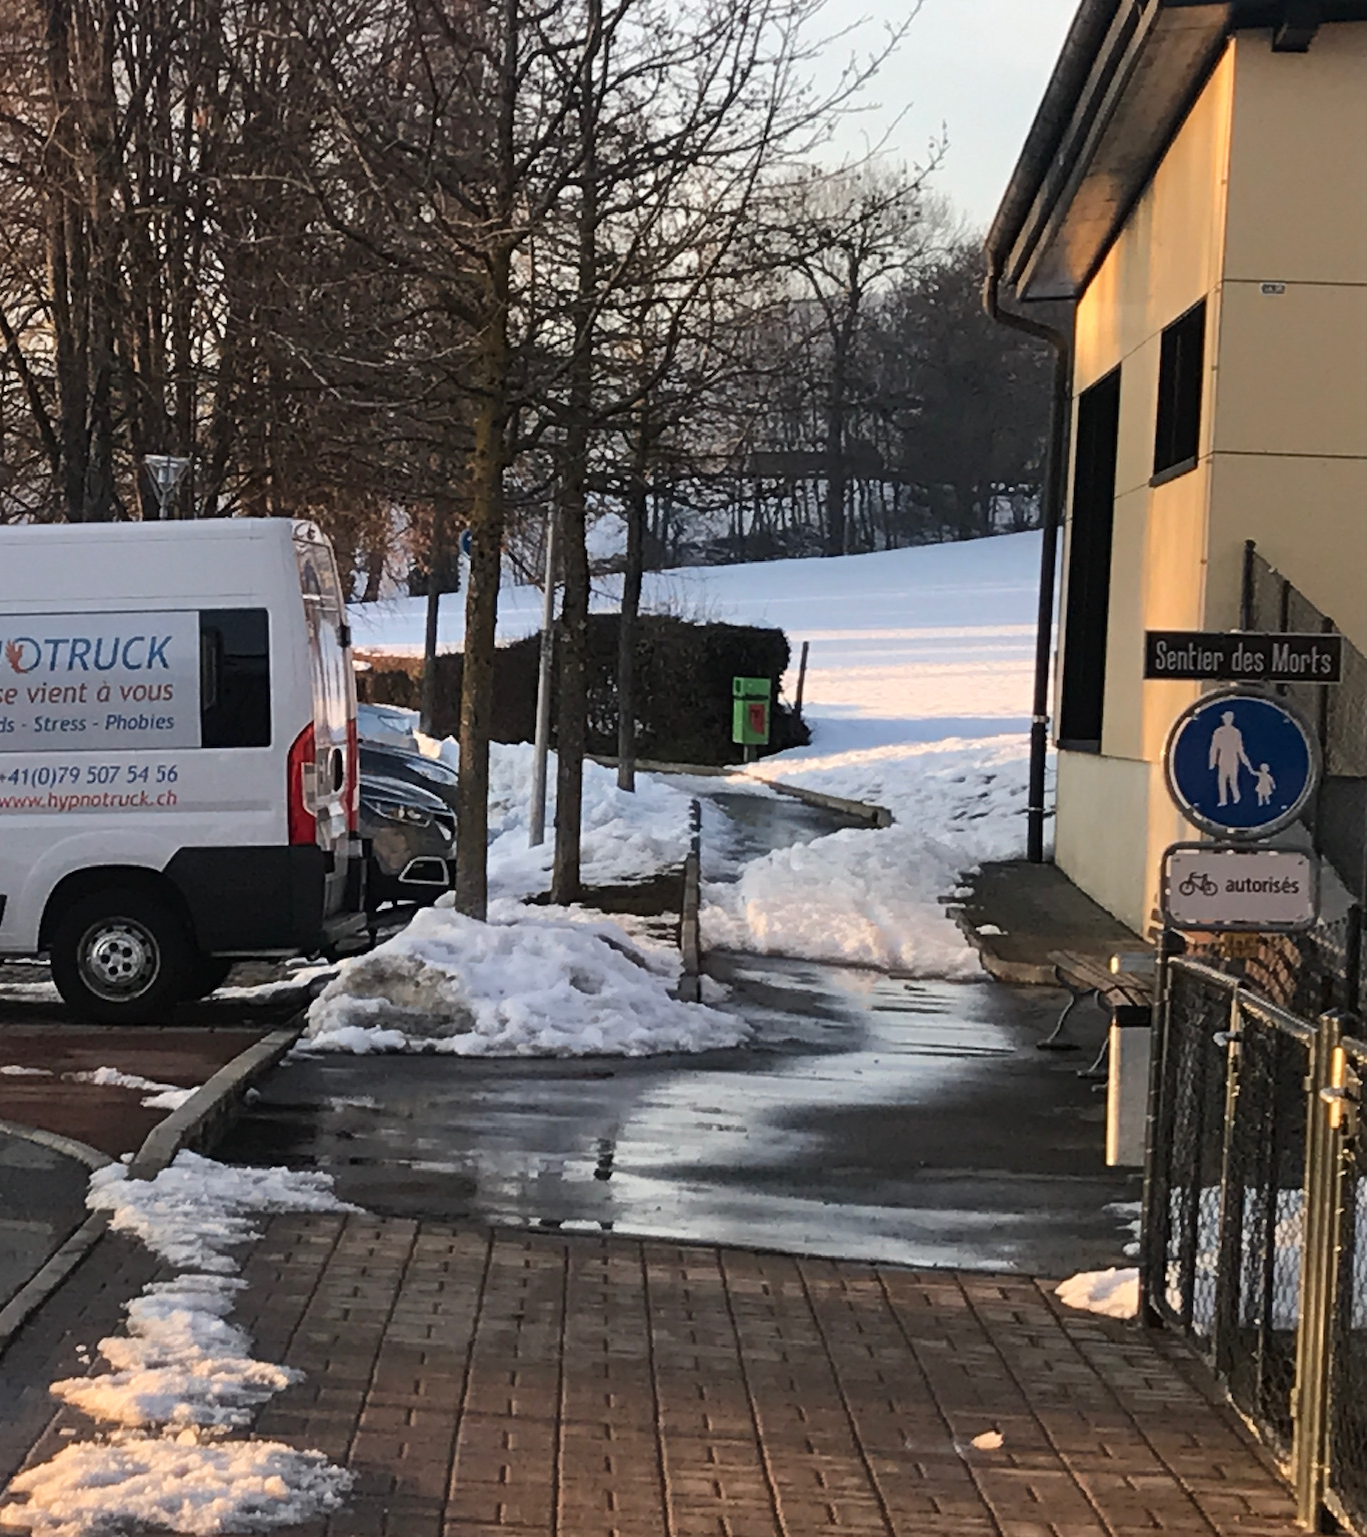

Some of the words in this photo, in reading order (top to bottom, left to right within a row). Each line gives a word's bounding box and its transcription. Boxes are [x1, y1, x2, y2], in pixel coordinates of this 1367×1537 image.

[1155, 640, 1224, 671] Sentier
[1231, 642, 1265, 672] des
[1271, 643, 1332, 674] Morts
[27, 682, 87, 703] vient
[96, 680, 111, 702] à
[119, 684, 173, 702] vous
[34, 716, 86, 732] Stress
[105, 714, 175, 730] Phobies
[86, 766, 120, 784] 507
[126, 765, 149, 783] 54
[156, 765, 178, 783] 56
[1225, 873, 1300, 894] autorisés
